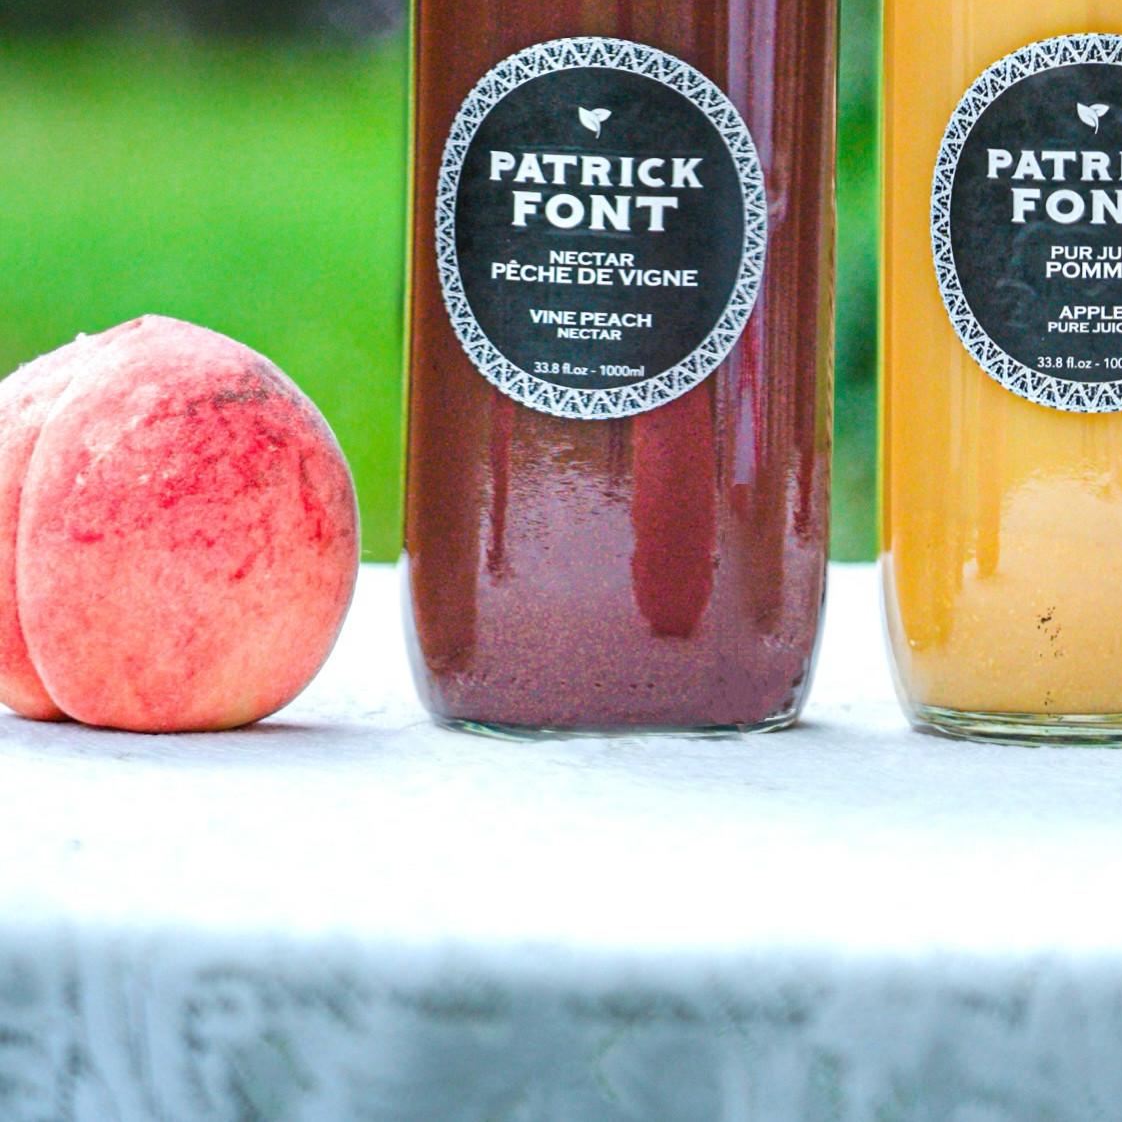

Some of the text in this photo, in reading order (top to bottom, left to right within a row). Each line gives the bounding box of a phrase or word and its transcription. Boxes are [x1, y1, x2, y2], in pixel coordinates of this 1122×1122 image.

[489, 150, 703, 189] PATRICK
[512, 191, 679, 232] FONT
[550, 251, 634, 266] NECTAR
[1051, 246, 1092, 260] PUR
[492, 260, 698, 287] PÊCHE DE VIGNE
[530, 309, 652, 327] VINE PEACH
[557, 328, 621, 340] NECTAR
[1047, 322, 1089, 333] PURE
[534, 361, 559, 374] 33.8
[561, 362, 588, 376] fl.oz
[599, 364, 644, 377] 1000ml
[1037, 357, 1063, 369] 33.8
[1066, 357, 1092, 369] fl.oz
